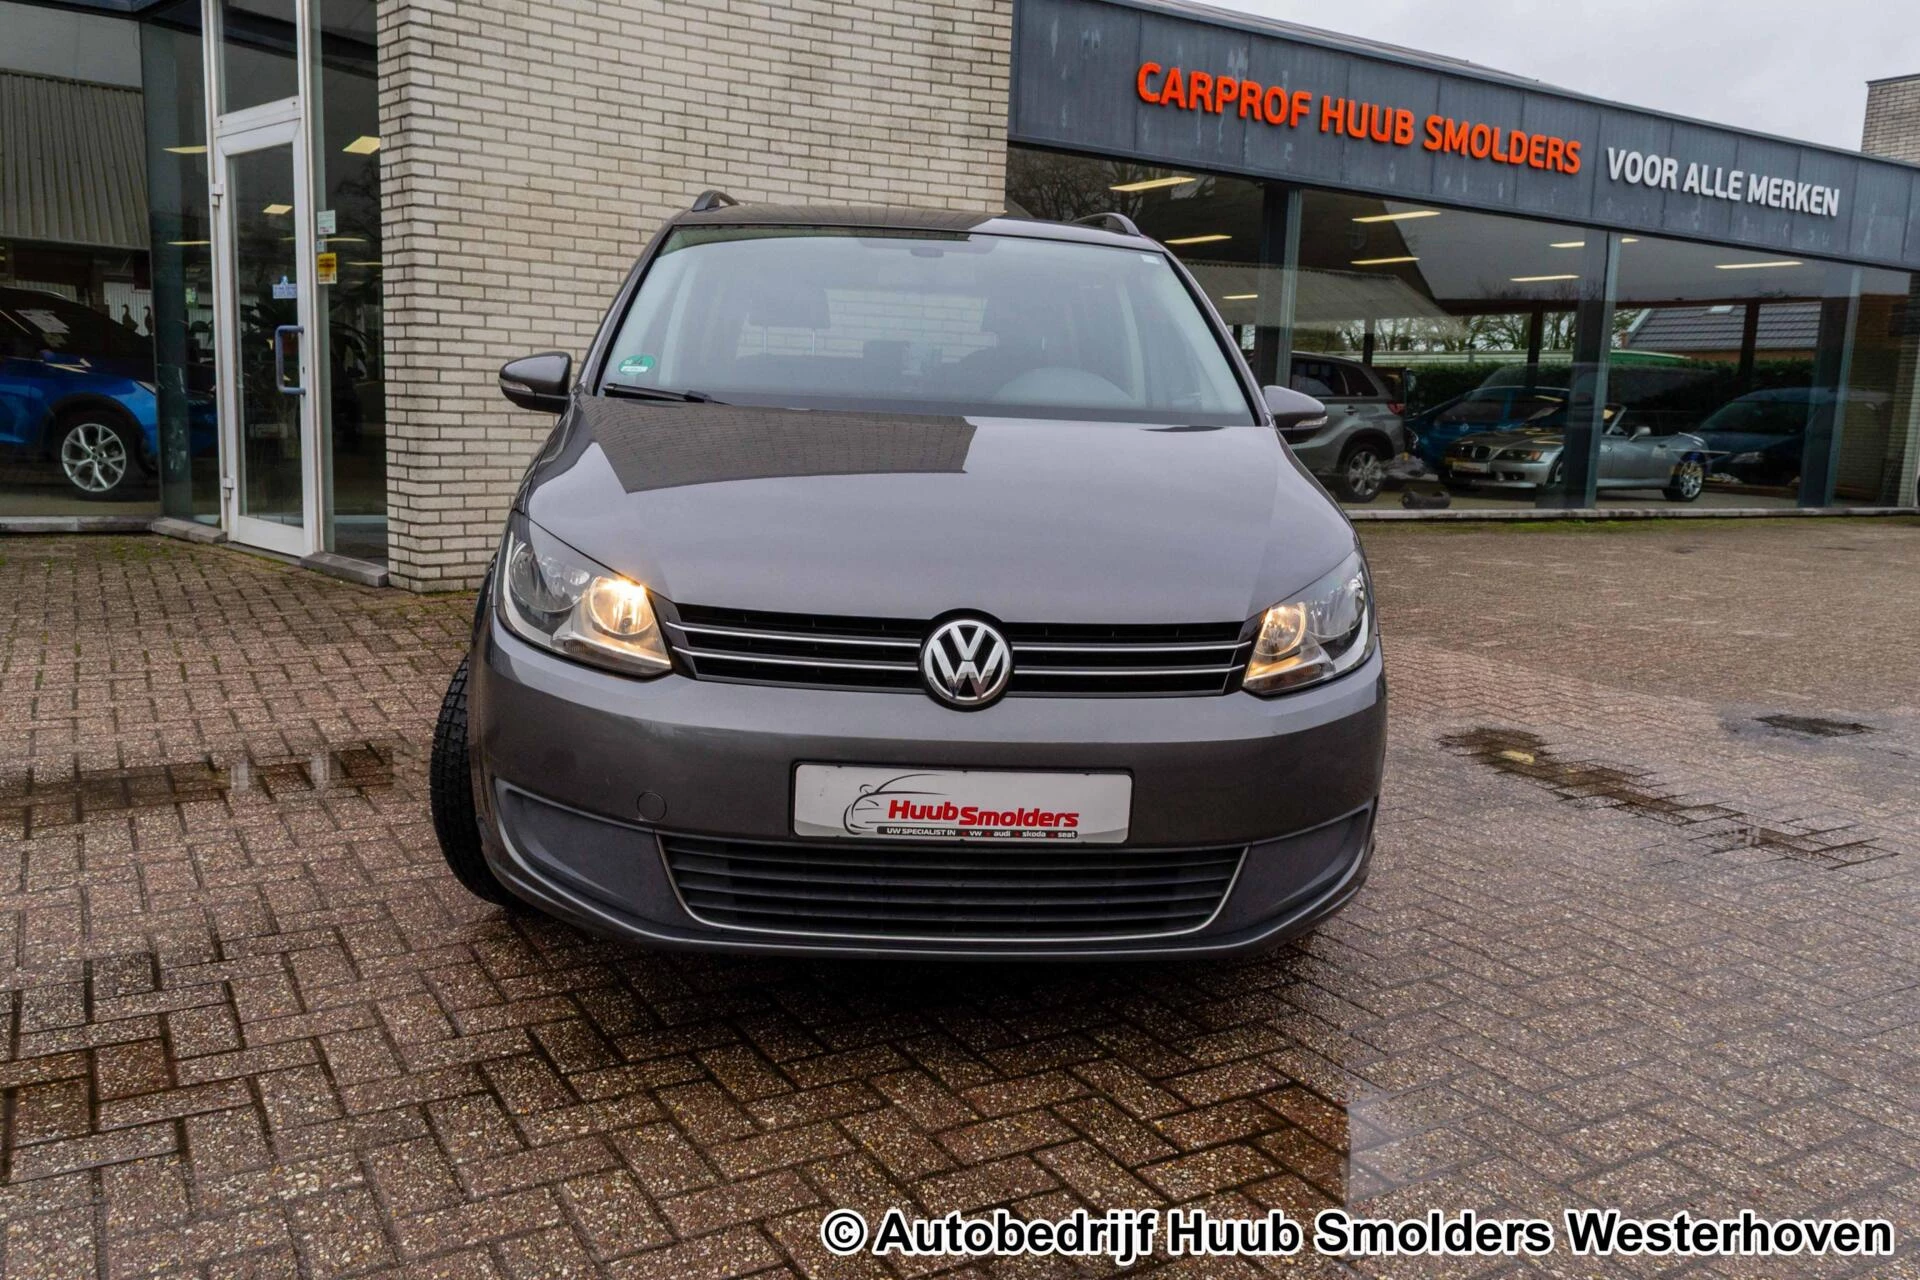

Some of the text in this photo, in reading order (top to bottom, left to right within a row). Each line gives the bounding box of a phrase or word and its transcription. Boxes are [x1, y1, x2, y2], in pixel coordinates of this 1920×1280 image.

[1136, 61, 1840, 217] CARPROF HUUB SMOLDERS VOOR ALLE MERKEN
[902, 828, 946, 836] SPECIALIST
[1022, 830, 1046, 838] skoda
[1057, 831, 1075, 839] seat
